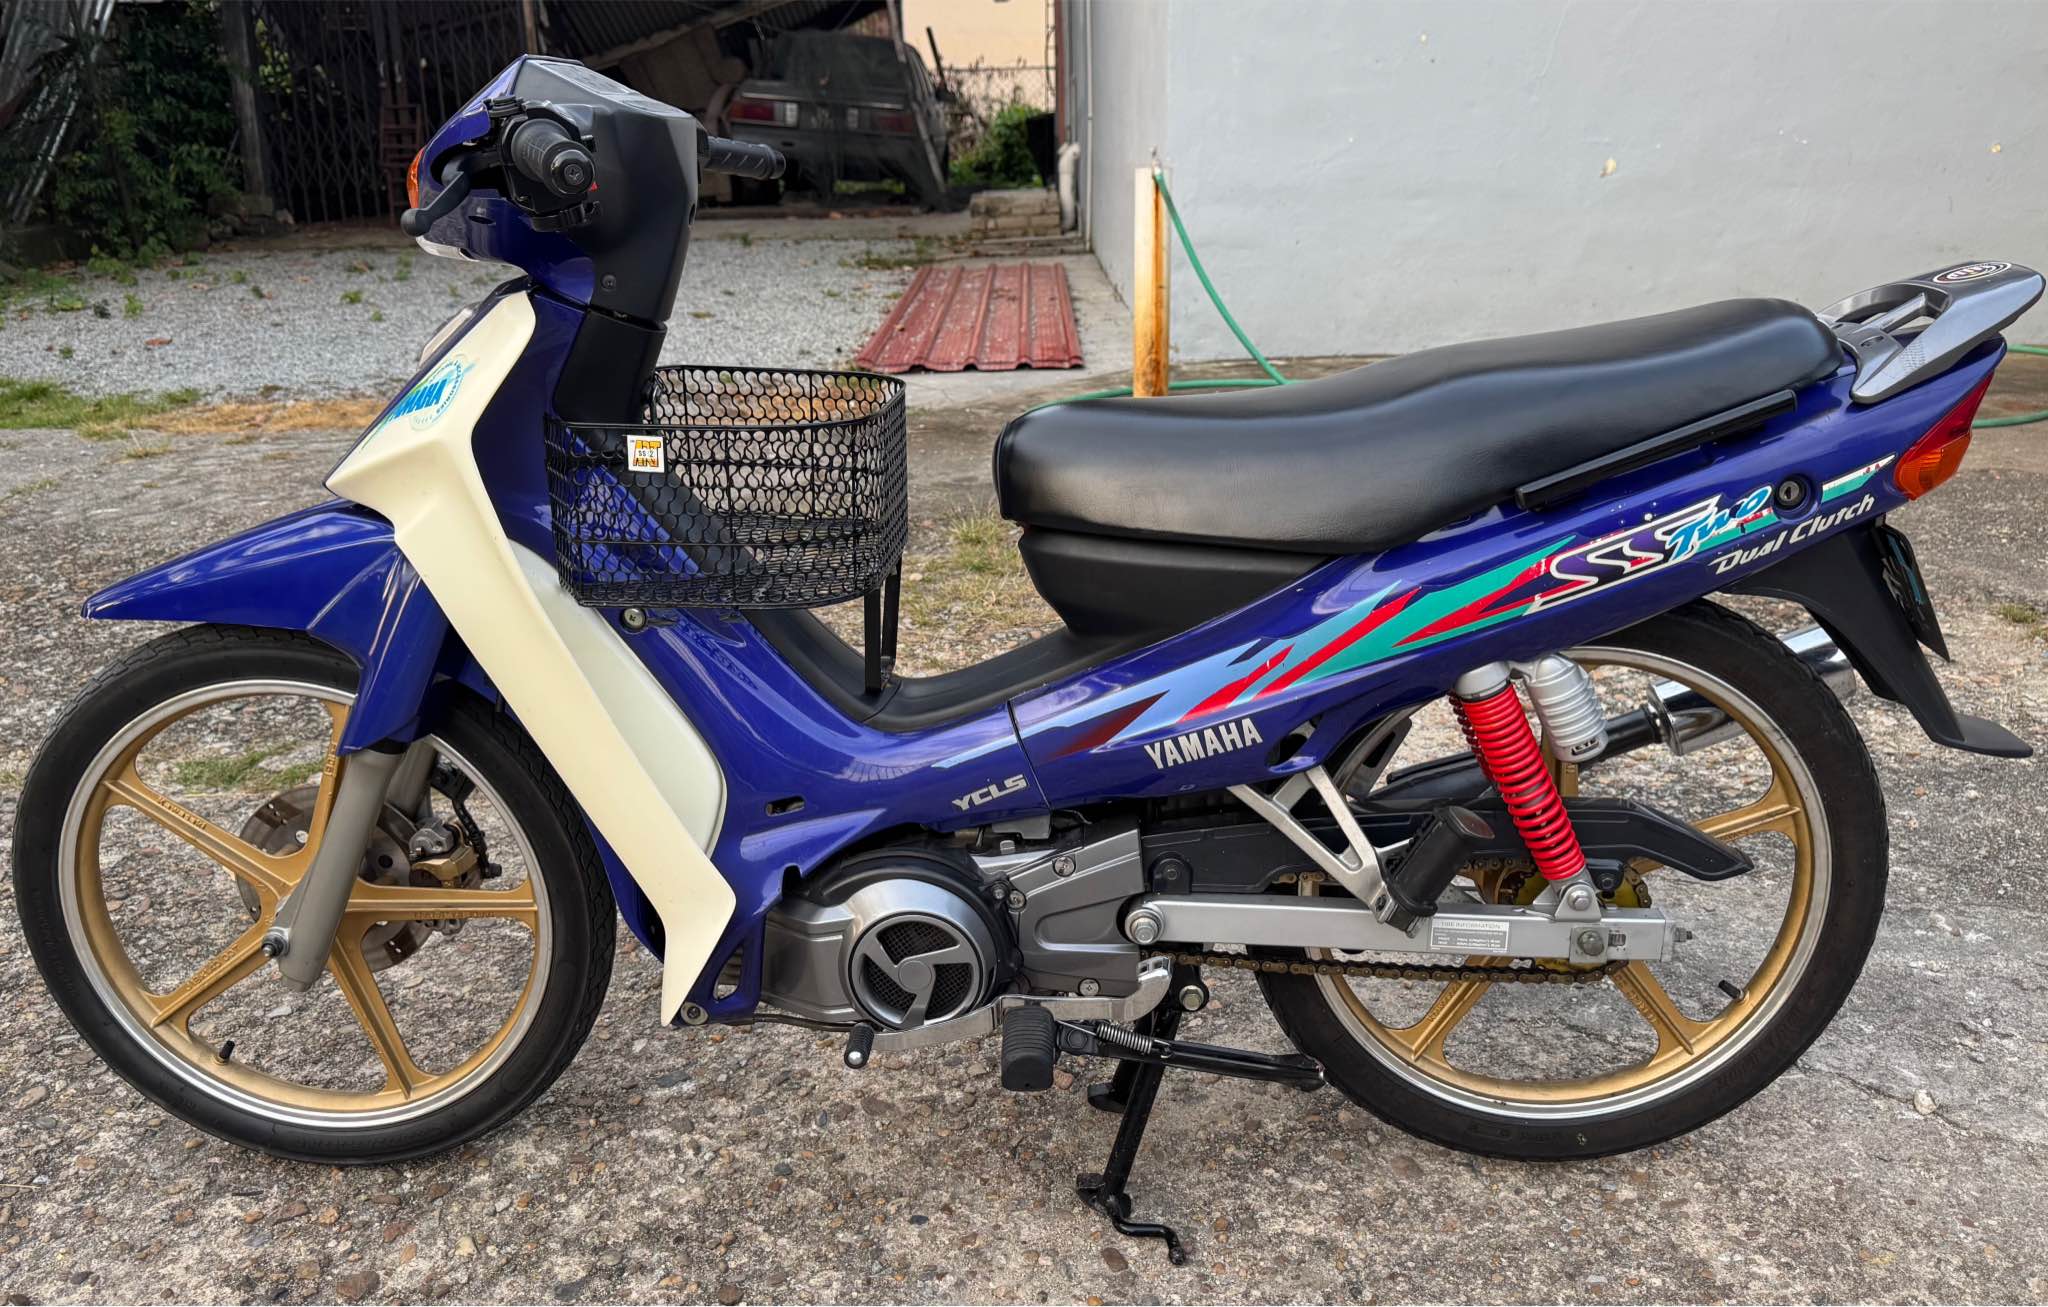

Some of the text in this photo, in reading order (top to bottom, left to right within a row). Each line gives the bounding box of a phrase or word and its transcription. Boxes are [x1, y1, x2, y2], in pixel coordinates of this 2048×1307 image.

[1666, 484, 1773, 564] Two
[1707, 493, 1876, 576] Dual Clutch
[1143, 717, 1264, 770] YAMAHA
[951, 773, 1029, 812] YCLS
